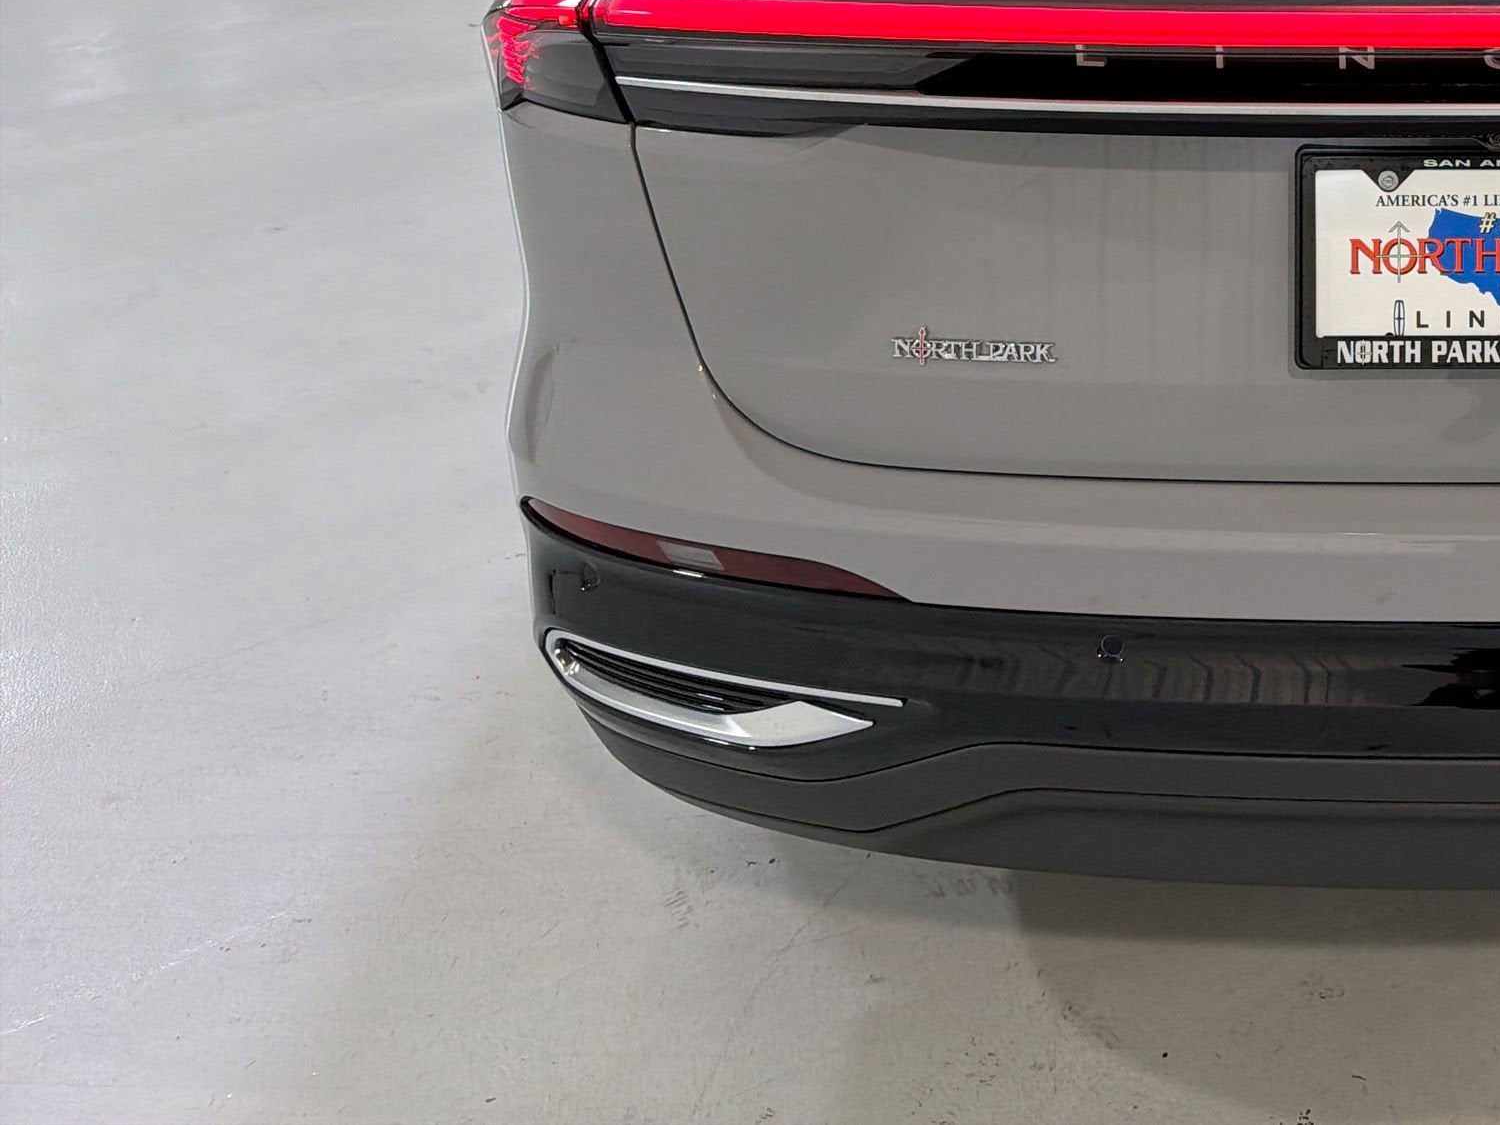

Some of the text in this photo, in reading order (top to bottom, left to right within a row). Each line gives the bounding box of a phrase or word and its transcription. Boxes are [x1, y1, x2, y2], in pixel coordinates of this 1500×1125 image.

[1423, 159, 1471, 168] SAN
[1375, 193, 1459, 207] AMERICA'S
[1463, 194, 1479, 207] #1
[1337, 340, 1421, 364] NORTH
